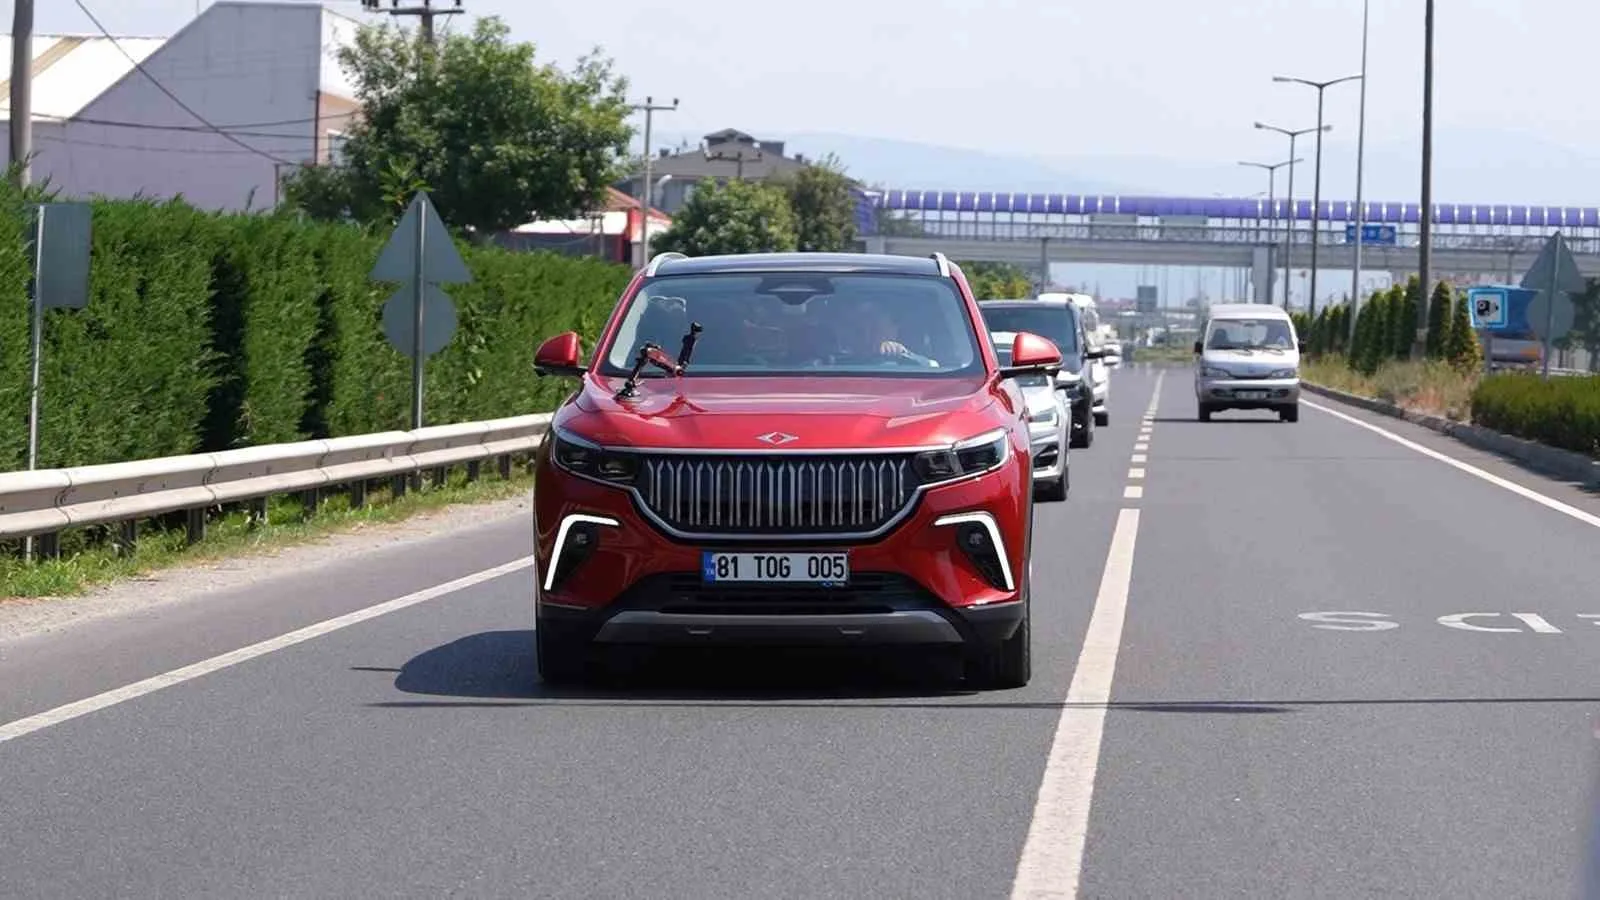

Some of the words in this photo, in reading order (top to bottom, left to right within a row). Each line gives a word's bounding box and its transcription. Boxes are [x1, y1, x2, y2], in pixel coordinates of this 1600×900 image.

[717, 556, 738, 578] 81
[753, 556, 790, 578] TOG
[808, 556, 845, 578] 005
[1298, 611, 1600, 633] DS
